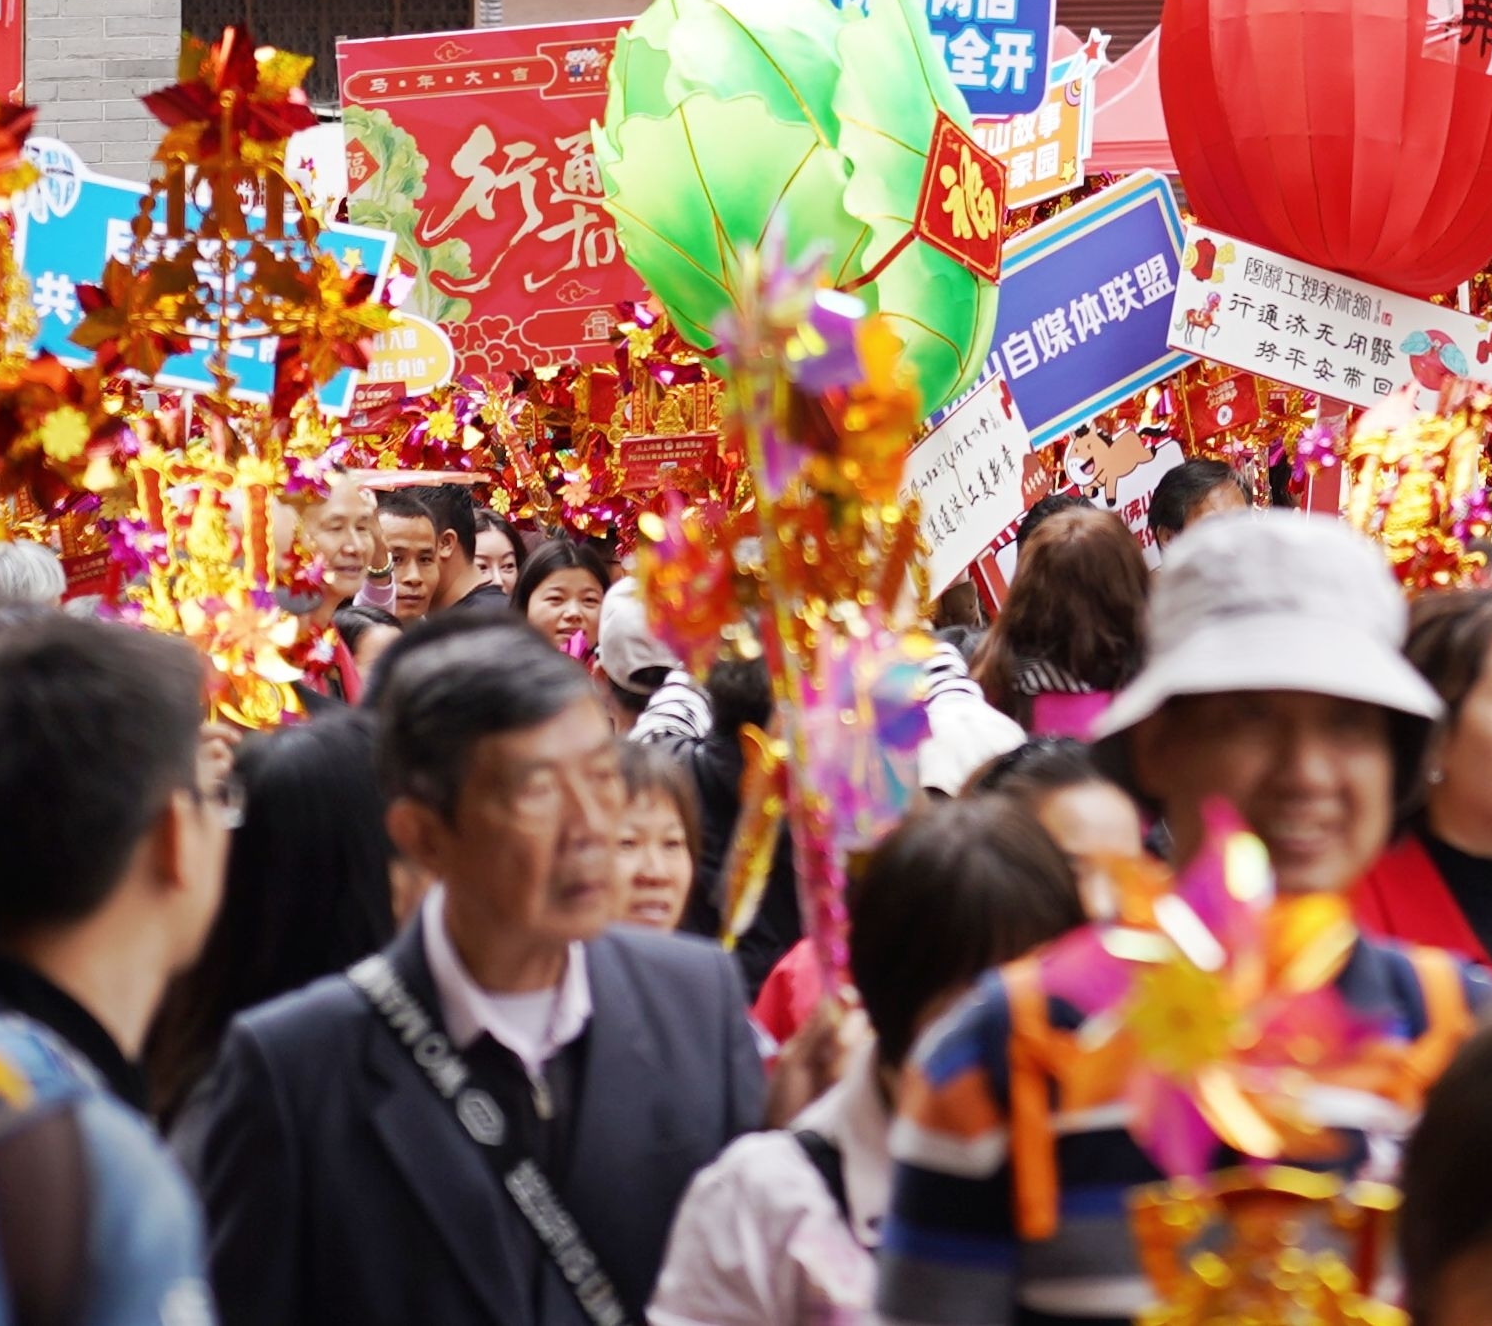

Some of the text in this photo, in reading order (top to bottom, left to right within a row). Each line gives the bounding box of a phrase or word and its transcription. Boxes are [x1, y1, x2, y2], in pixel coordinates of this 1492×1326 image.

[930, 27, 1034, 90] 全开
[1005, 141, 1059, 189] 家园
[942, 253, 1176, 417] 山自媒体联盟
[1255, 340, 1420, 411] 将平安带回
